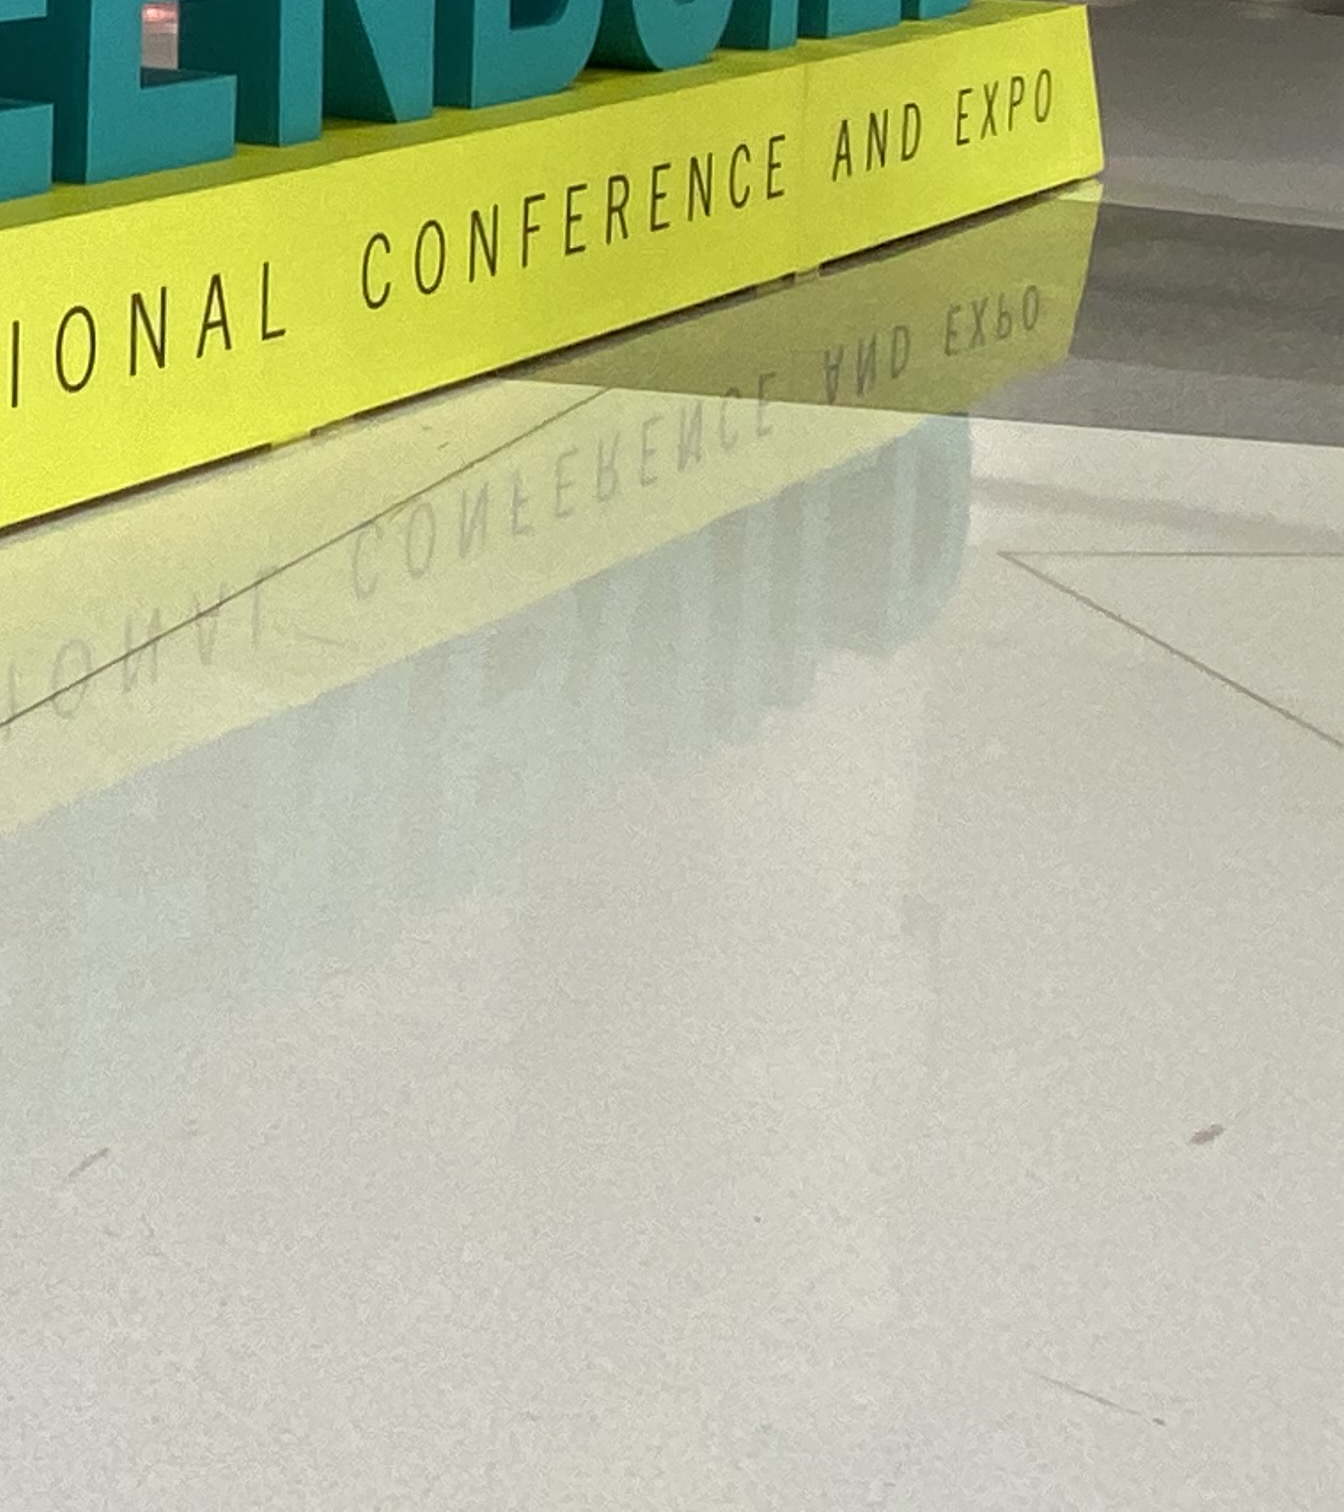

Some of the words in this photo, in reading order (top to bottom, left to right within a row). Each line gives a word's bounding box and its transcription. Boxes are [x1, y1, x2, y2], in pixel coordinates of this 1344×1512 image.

[361, 134, 788, 311] CONFERENCE
[831, 102, 923, 182] AND
[955, 67, 1055, 148] EXPO
